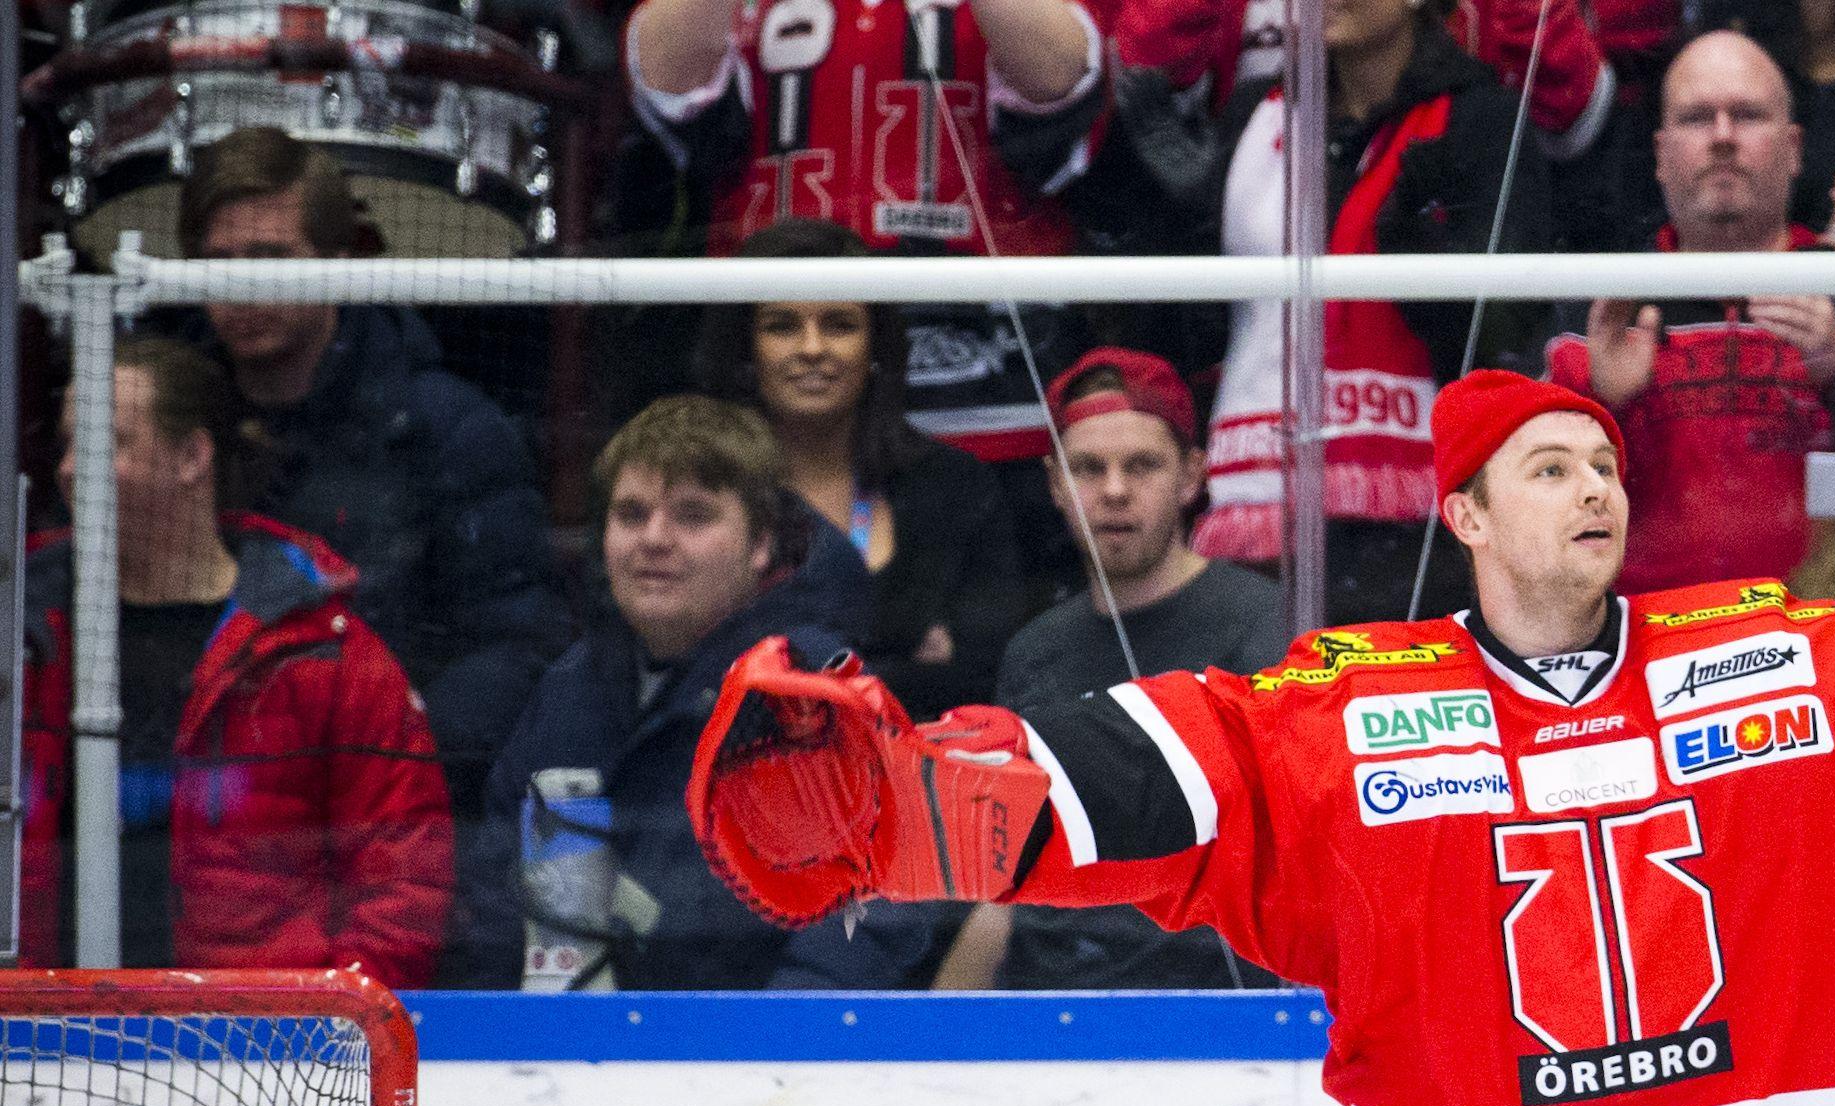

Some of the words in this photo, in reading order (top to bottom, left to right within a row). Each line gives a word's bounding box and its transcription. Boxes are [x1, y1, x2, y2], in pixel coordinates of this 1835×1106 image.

[1537, 654, 1591, 673] SHL
[1361, 694, 1492, 749] DANFO
[1674, 704, 1815, 772] ELON
[1363, 770, 1512, 815] Gustavsvik
[1545, 780, 1638, 807] CONCENT
[992, 801, 1007, 873] CCM
[1533, 1035, 1718, 1099] ÖREBRO
